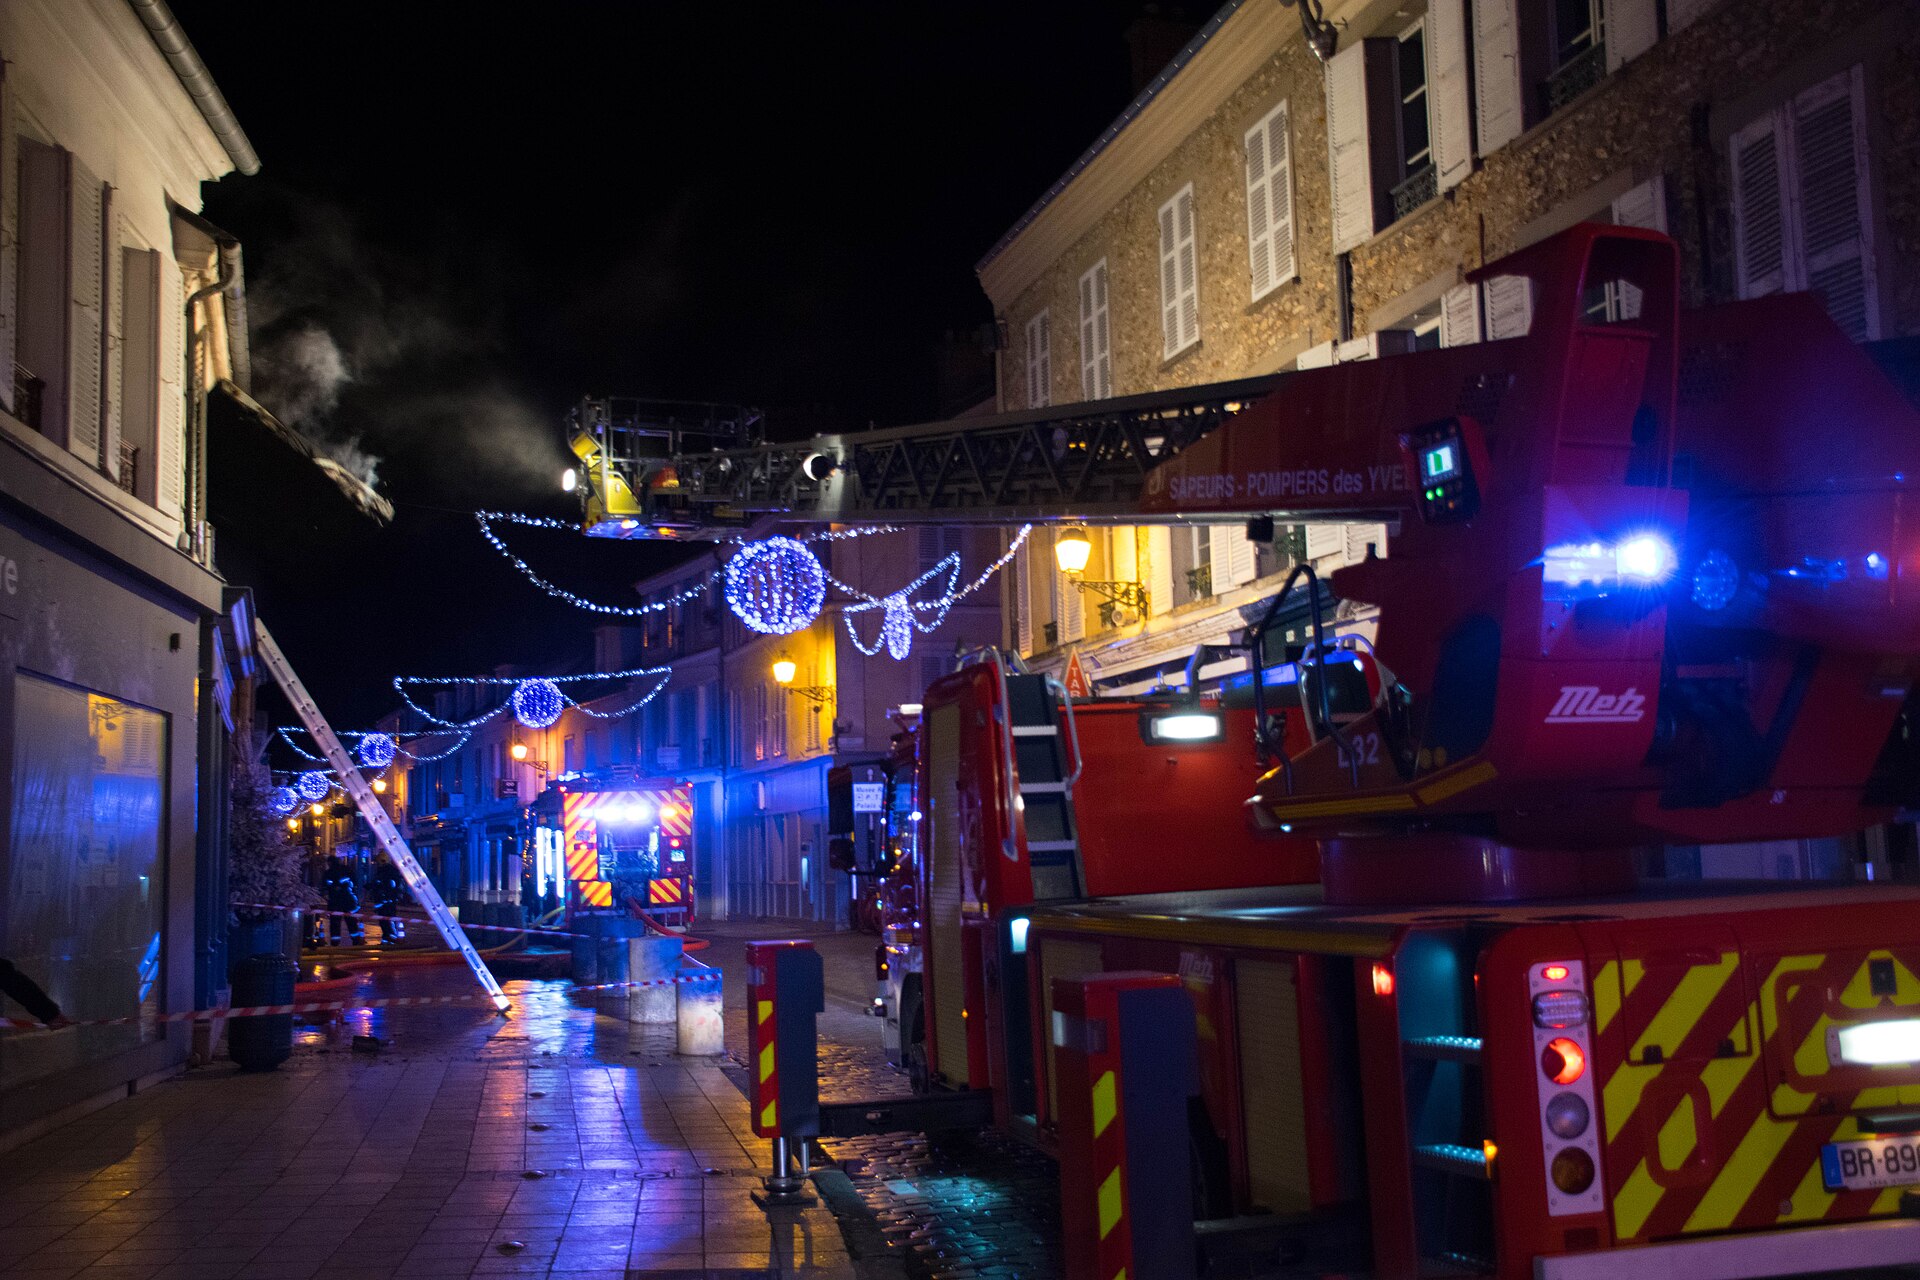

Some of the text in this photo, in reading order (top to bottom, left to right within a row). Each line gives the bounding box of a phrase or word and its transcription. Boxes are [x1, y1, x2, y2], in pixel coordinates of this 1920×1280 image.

[1169, 473, 1235, 500] SAPEURS
[1247, 469, 1329, 497] POMPIERS
[1333, 469, 1363, 495] des
[1544, 686, 1646, 723] Metz
